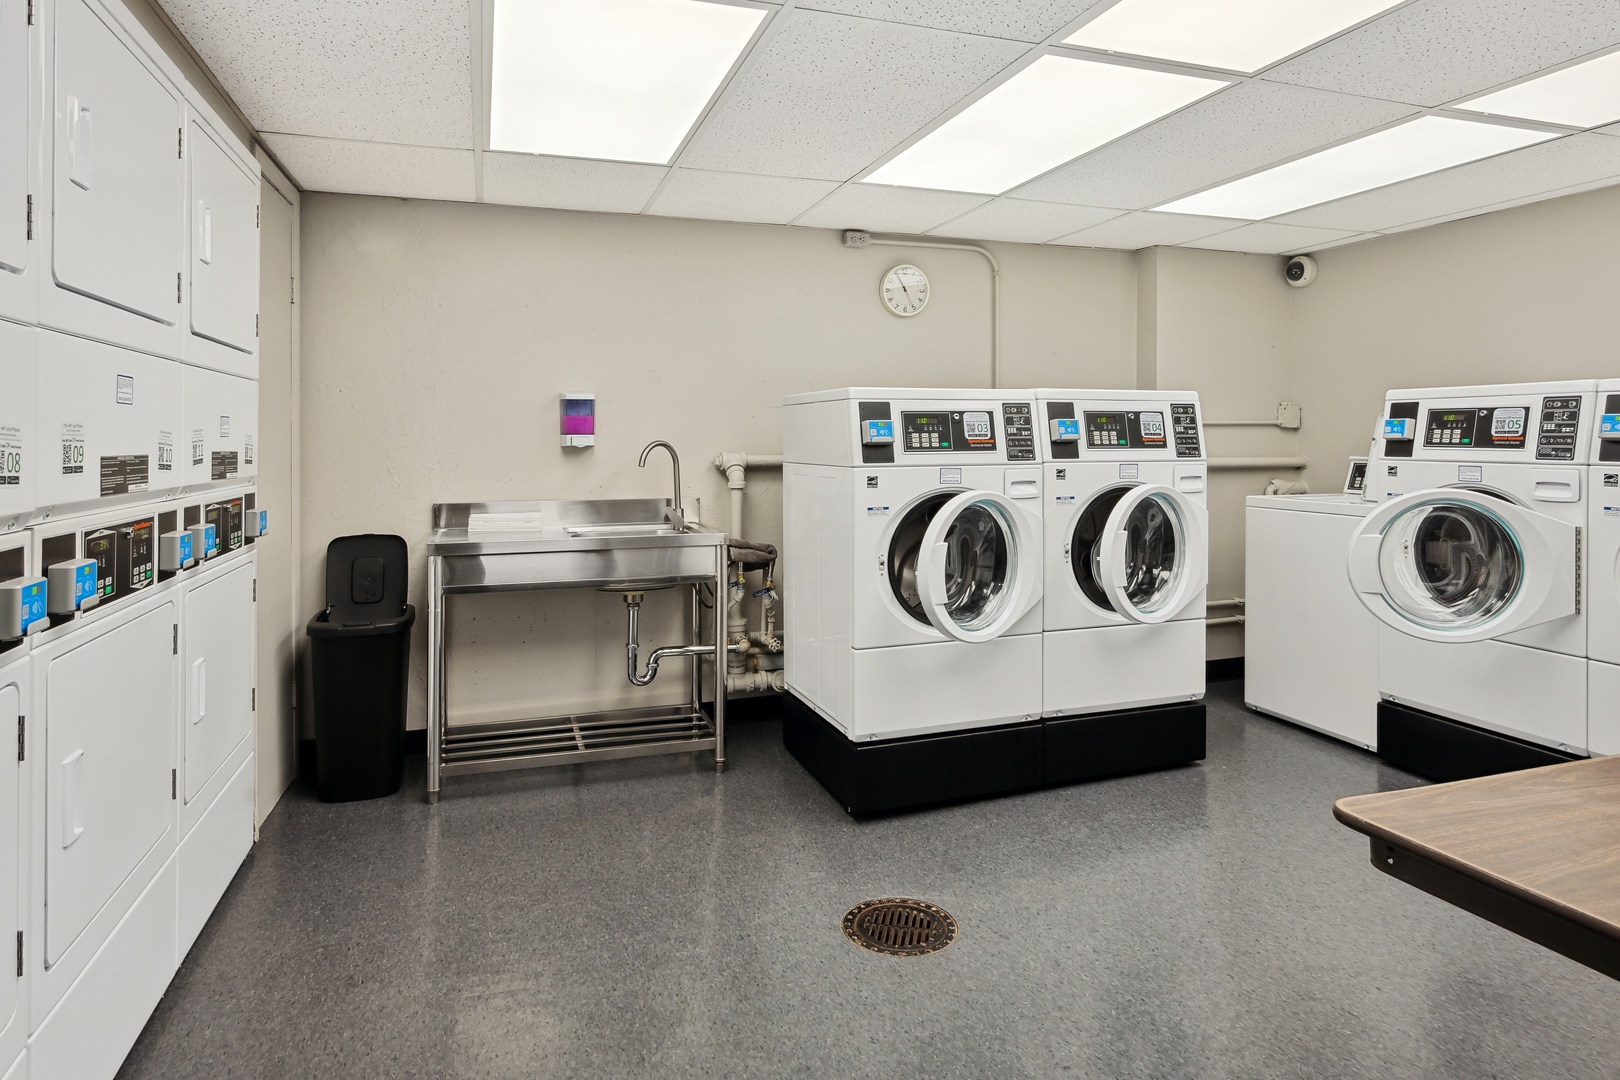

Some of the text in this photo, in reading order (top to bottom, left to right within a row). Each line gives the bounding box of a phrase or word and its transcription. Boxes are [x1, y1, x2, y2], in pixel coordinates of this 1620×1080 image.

[977, 424, 988, 432] 03
[1507, 420, 1521, 429] 05
[73, 446, 84, 463] 09
[166, 449, 172, 462] 10
[198, 444, 203, 457] 11
[7, 452, 20, 473] 08
